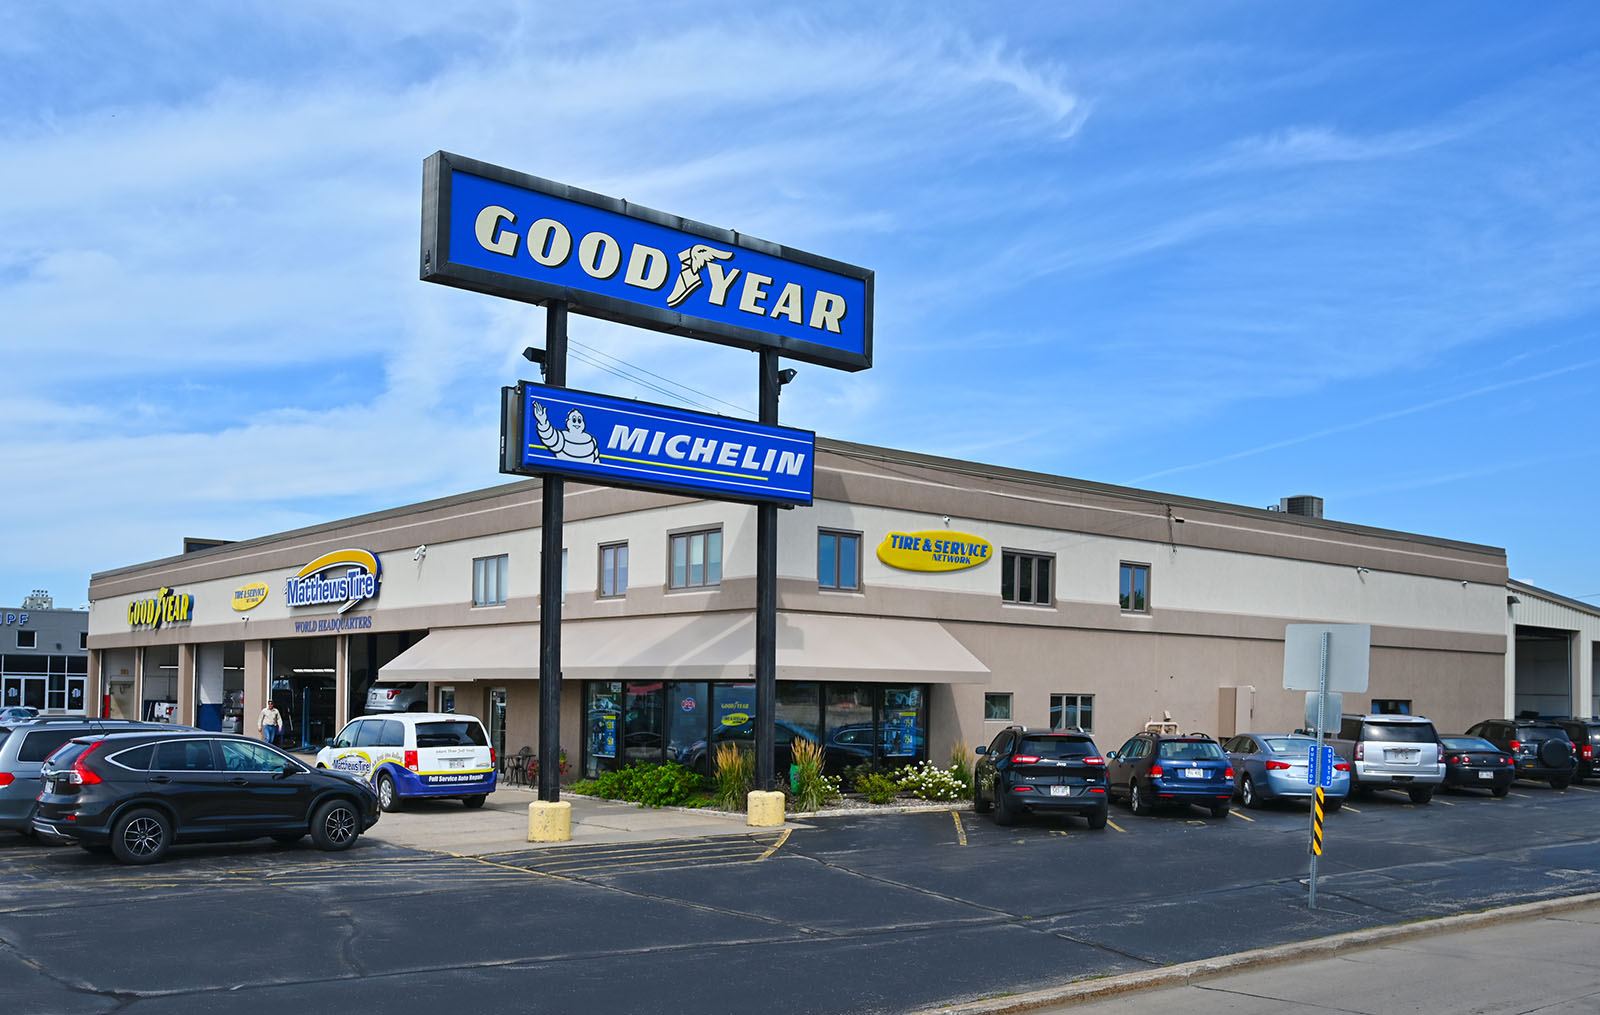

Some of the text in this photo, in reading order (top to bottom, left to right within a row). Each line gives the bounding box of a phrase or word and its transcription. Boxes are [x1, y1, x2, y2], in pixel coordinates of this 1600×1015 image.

[475, 205, 847, 334] GOODYEAR
[607, 424, 805, 477] MICHELIN
[891, 534, 988, 558] TIRE & SERVICE
[932, 553, 971, 565] NETWORK
[128, 590, 190, 626] GOODYEAR
[0, 612, 29, 626] PF
[295, 615, 372, 633] WORLD HEADQUARTERS
[428, 775, 439, 783] Full
